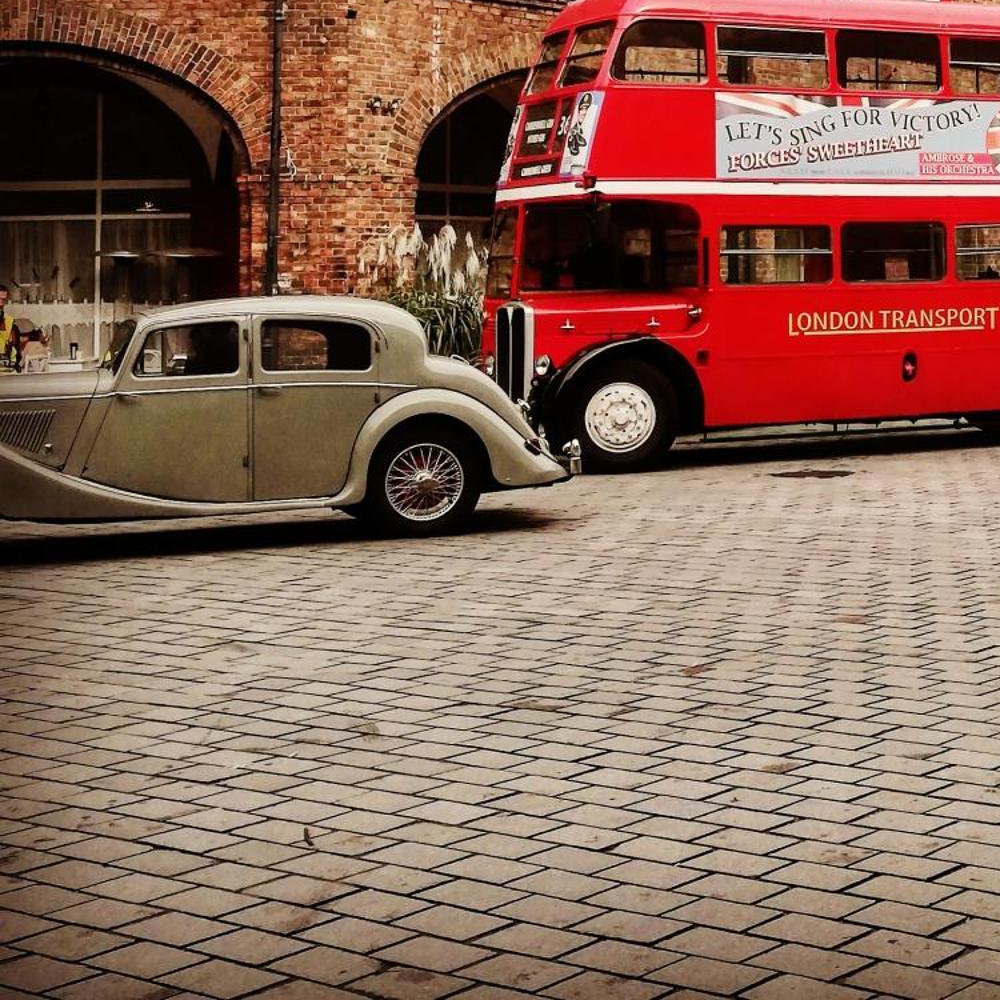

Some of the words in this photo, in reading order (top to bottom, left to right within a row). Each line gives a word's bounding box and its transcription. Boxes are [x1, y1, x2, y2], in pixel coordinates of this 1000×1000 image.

[725, 121, 783, 146] LET'S
[790, 114, 836, 146] SING
[841, 108, 882, 128] FOR
[890, 102, 981, 132] VICTORY!
[807, 132, 923, 163] SWEETHEART
[921, 152, 964, 162] AMBROSE
[966, 153, 975, 162] &
[922, 164, 938, 174] HIS
[940, 164, 995, 175] ORCHESTRA
[788, 311, 874, 337] LONDON
[878, 307, 999, 331] TRANSPORT
